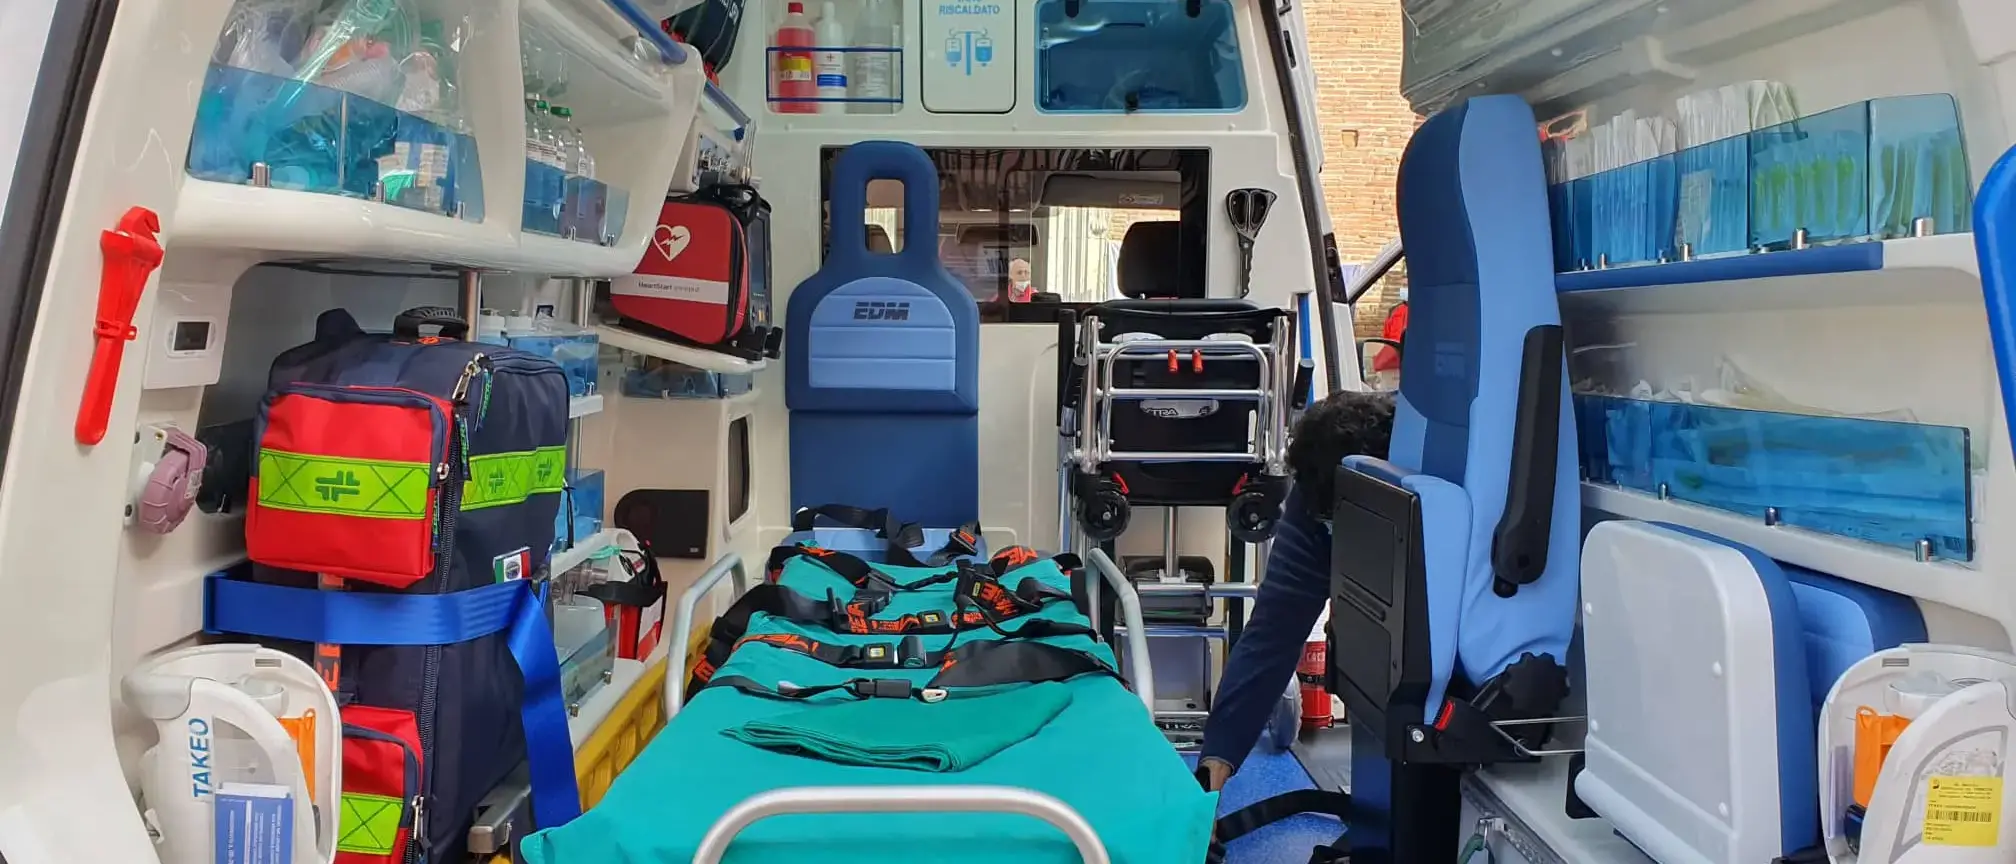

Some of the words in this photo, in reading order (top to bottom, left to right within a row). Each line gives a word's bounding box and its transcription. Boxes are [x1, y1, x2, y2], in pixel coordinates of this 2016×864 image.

[939, 4, 1001, 15] RISCALDATO
[638, 280, 673, 291] HeartStart
[854, 301, 910, 320] EDM
[188, 717, 213, 798] TAKEO
